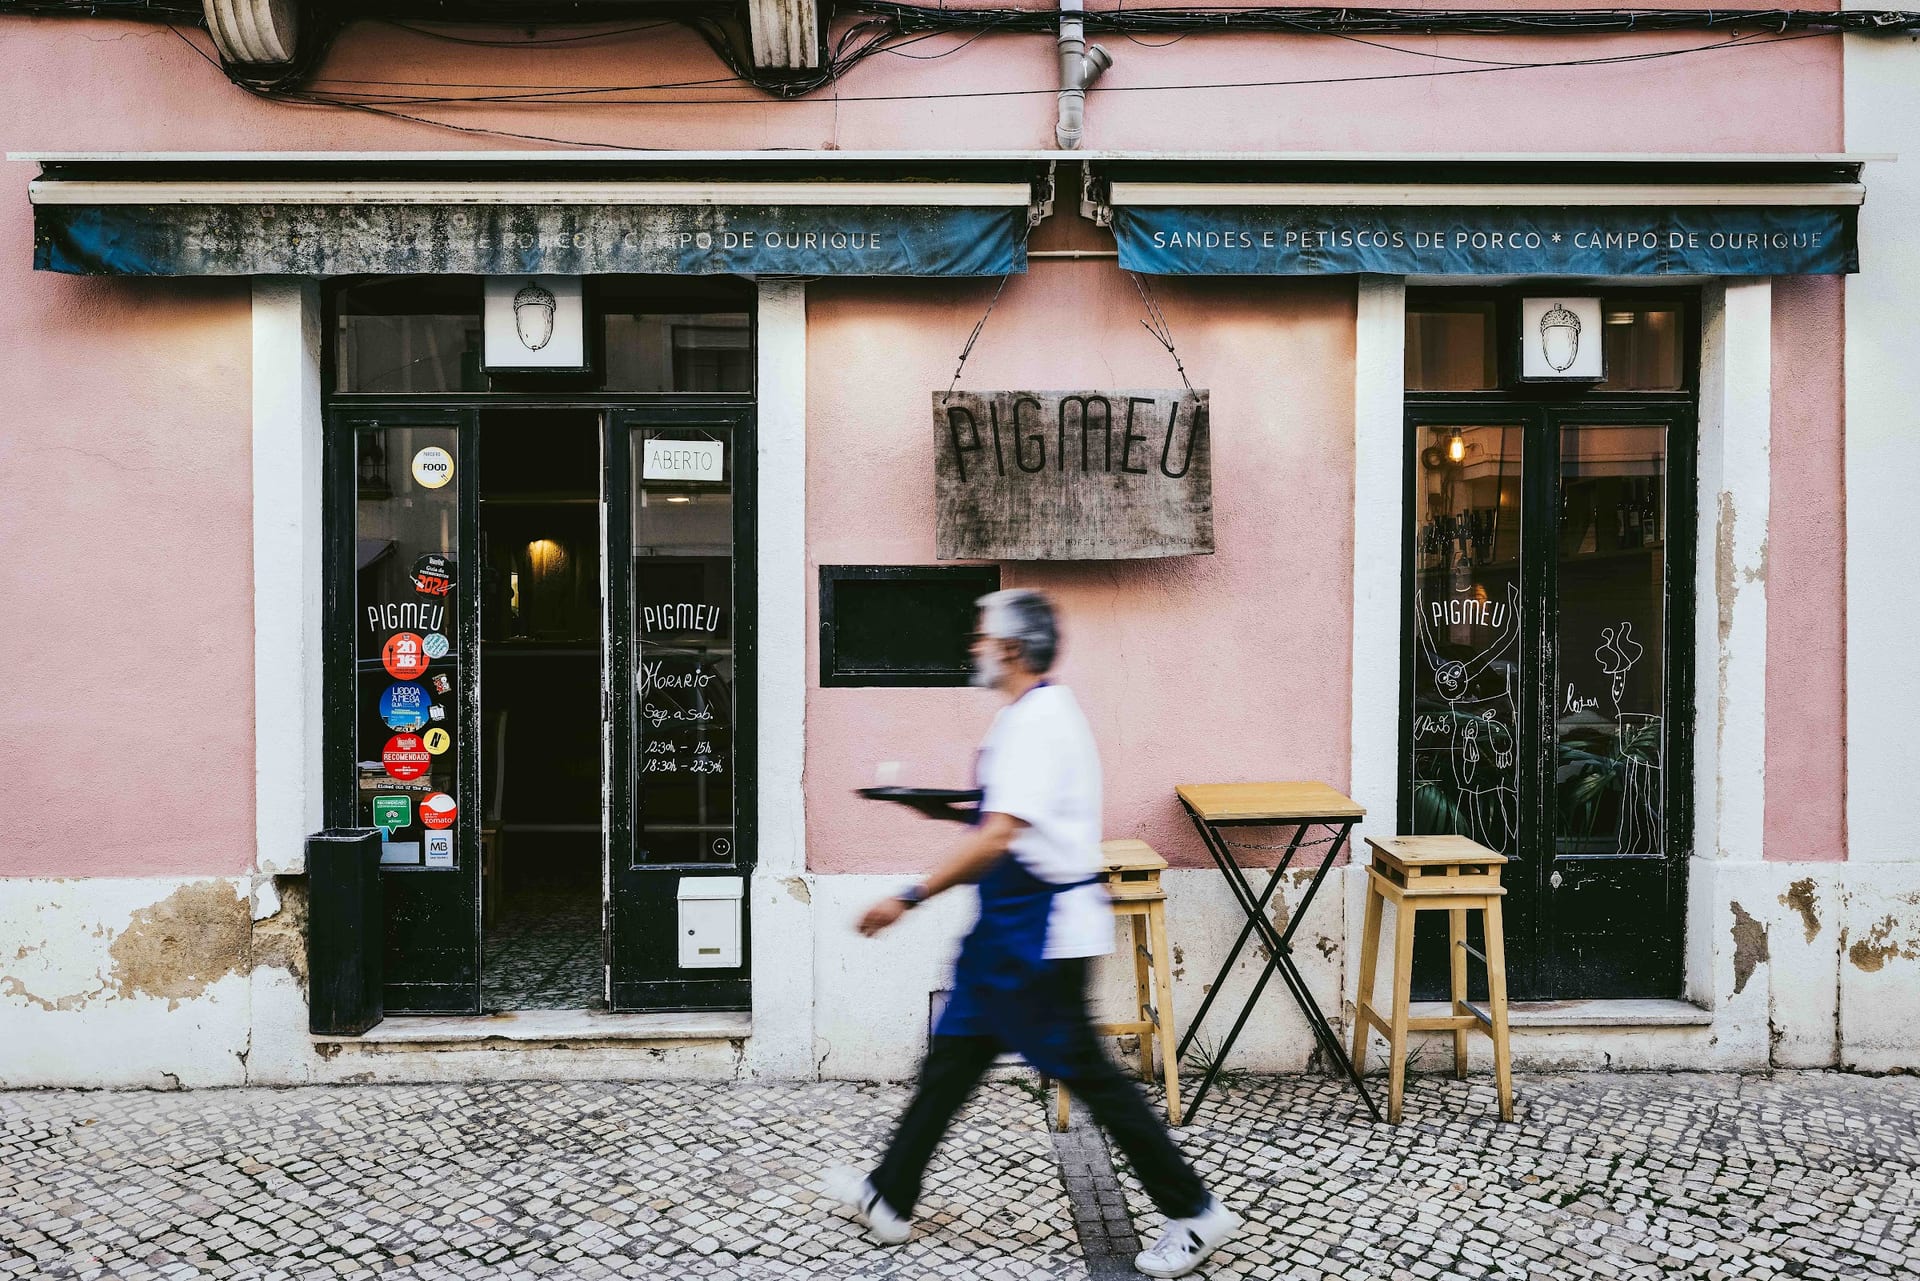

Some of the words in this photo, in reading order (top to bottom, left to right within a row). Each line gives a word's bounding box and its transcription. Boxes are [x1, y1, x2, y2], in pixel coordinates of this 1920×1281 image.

[724, 232, 753, 249] DE
[765, 231, 881, 250] OURIQUE
[1153, 231, 1251, 248] SANDES
[1263, 231, 1274, 248] E
[1286, 231, 1404, 248] PETISCOS
[1415, 232, 1445, 249] DE
[1456, 232, 1541, 249] PORCO
[1574, 232, 1657, 249] CAMPO
[1669, 232, 1699, 249] DE
[1710, 232, 1822, 250] OURIQUE
[947, 395, 1203, 482] PIGMEU
[423, 463, 447, 471] FOOD
[651, 450, 713, 471] ABERTO
[416, 574, 449, 597] 2024
[368, 602, 445, 632] PIGMEU
[644, 602, 720, 632] PIGMEU
[1431, 599, 1505, 628] PIGMEU
[397, 640, 416, 653] 20
[397, 654, 416, 667] 16
[392, 687, 421, 695] LISBOA
[694, 741, 711, 754] 15h
[690, 759, 723, 774] 22:30h
[430, 842, 448, 851] MB
